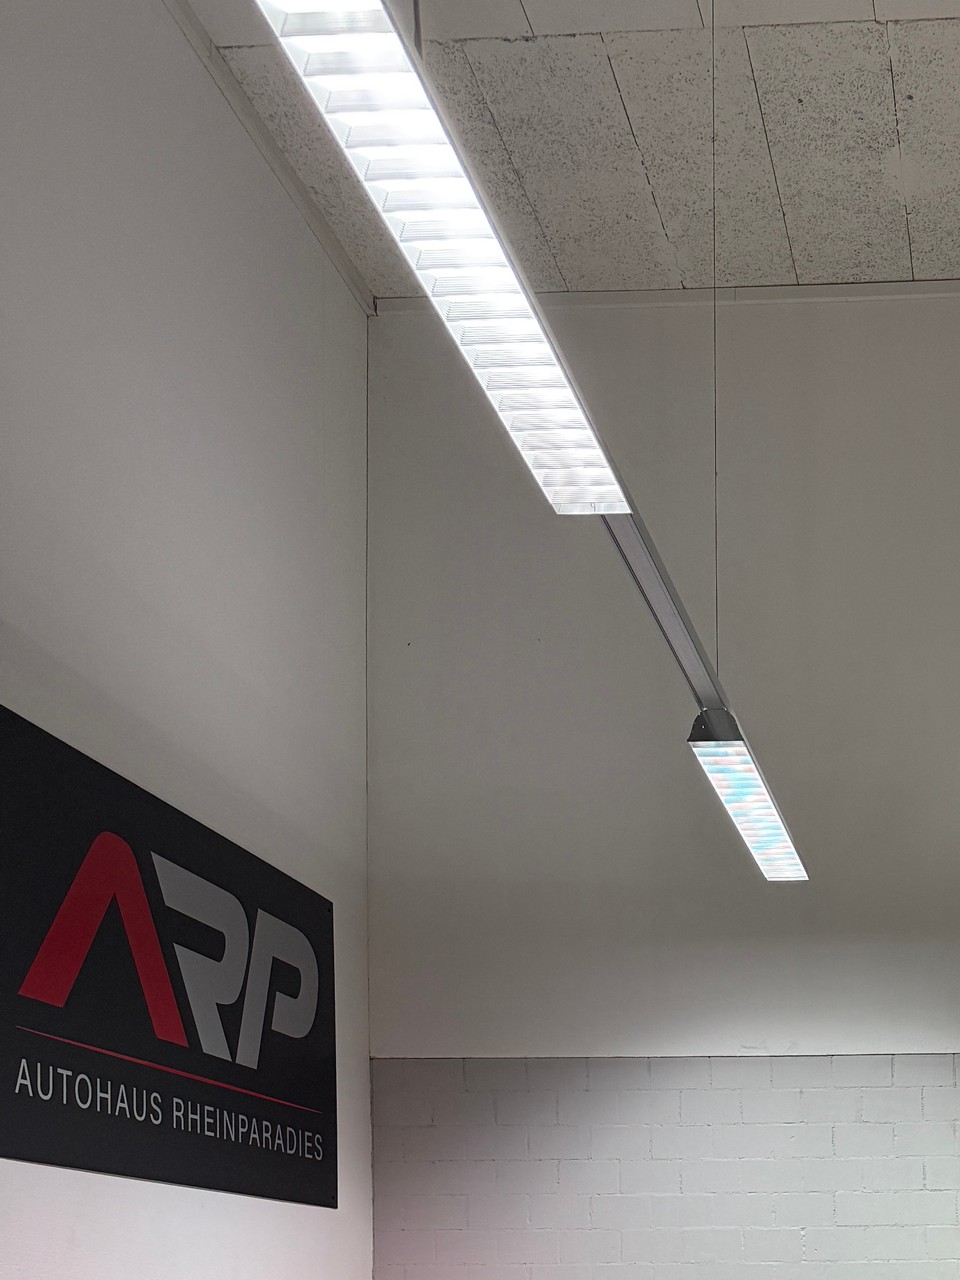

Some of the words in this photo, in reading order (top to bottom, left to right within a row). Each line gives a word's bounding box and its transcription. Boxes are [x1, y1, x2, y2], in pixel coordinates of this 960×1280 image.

[18, 831, 319, 1070] ARP
[15, 1058, 162, 1125] AUTOHAUS
[172, 1097, 323, 1161] RHEINPARADIES
